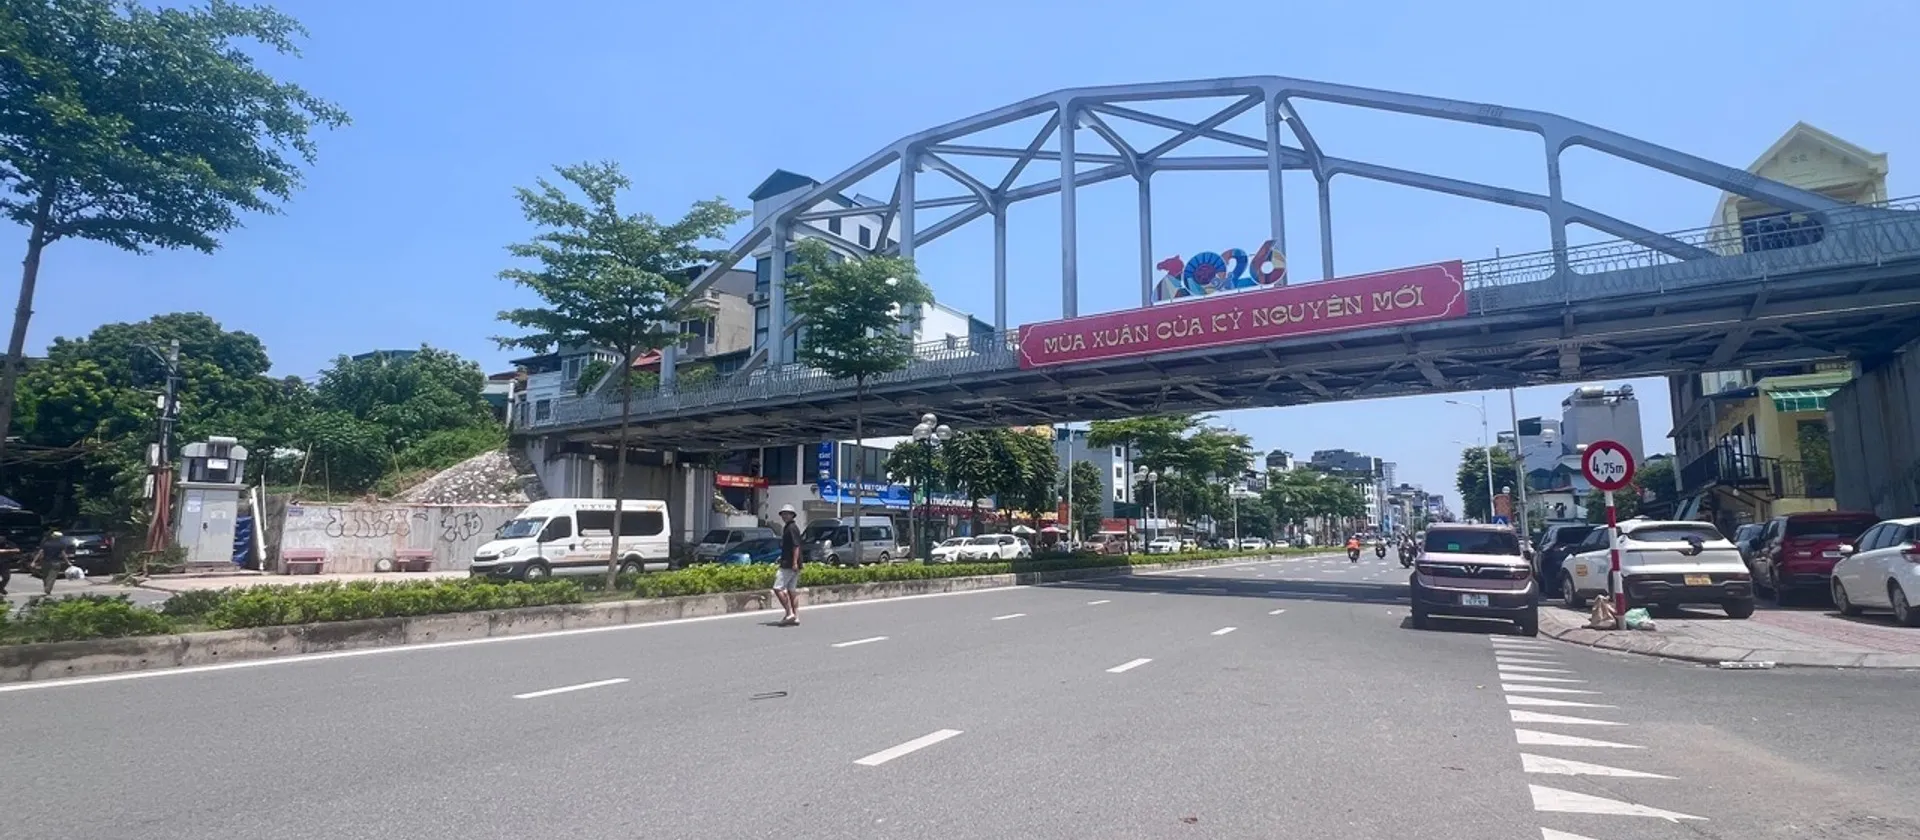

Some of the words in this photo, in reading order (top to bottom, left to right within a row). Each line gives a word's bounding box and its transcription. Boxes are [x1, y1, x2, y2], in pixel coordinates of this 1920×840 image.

[1044, 333, 1086, 354] MÙA
[1092, 324, 1149, 349] XUÂN
[1156, 315, 1204, 340] CỦA
[1211, 306, 1244, 332] KỶ
[1252, 293, 1364, 327] NGUYÊN
[1372, 283, 1425, 312] MỚI
